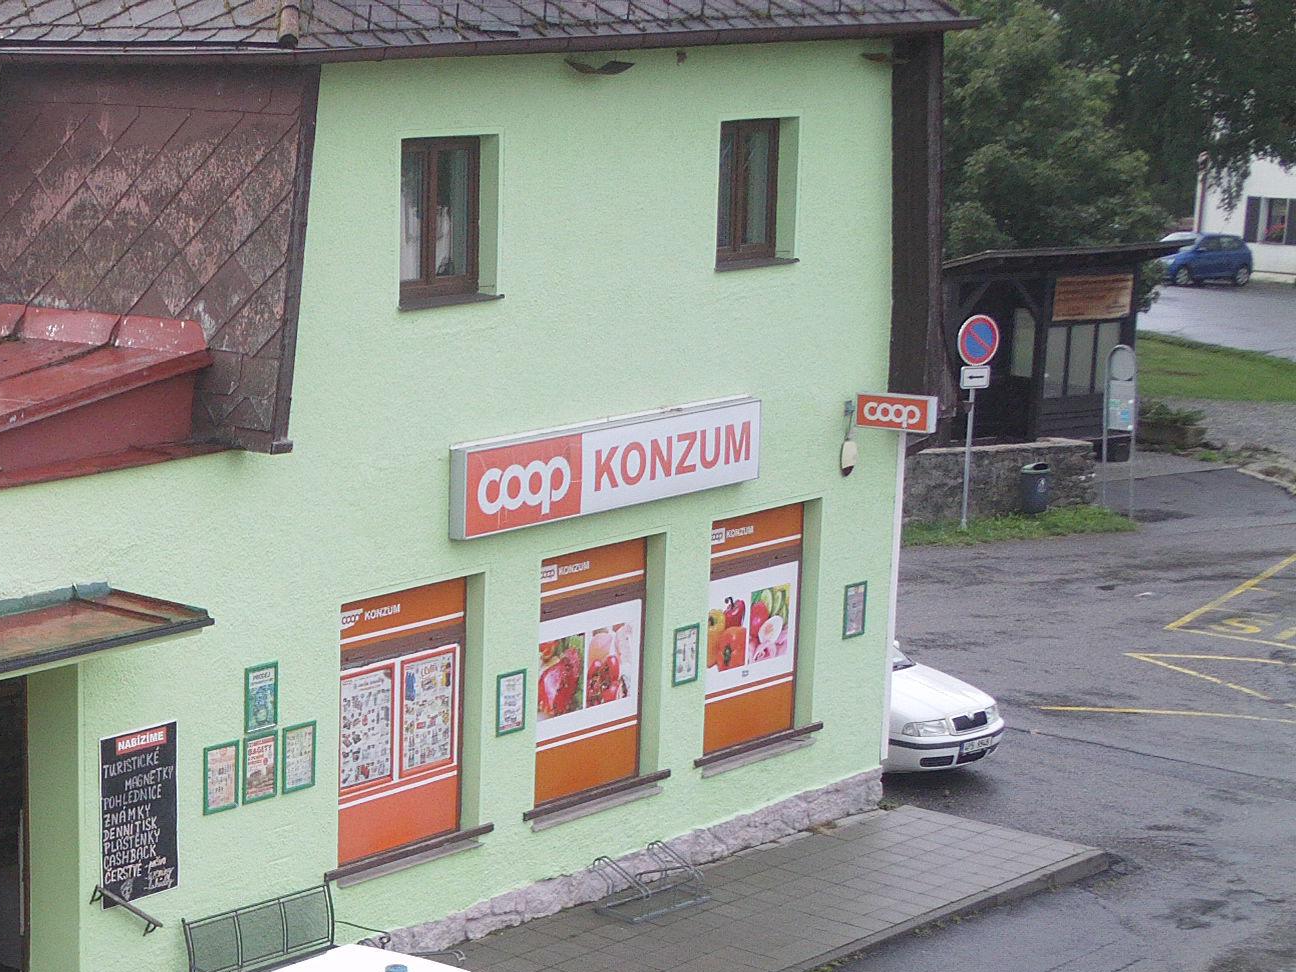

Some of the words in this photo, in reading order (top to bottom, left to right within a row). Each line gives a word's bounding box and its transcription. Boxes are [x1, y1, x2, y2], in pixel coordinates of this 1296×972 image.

[863, 401, 921, 428] coop
[477, 456, 571, 515] coop
[593, 420, 752, 493] KONZUM
[364, 604, 401, 620] KONZUM
[117, 731, 165, 750] NABÍZÍME
[103, 746, 160, 778] TURISTICKÉ
[124, 766, 174, 791] MAGNETKY
[102, 783, 162, 811] POHLEDNICE
[104, 803, 151, 827] ZNÁMKY
[134, 816, 157, 832] TISK
[103, 844, 157, 870] CASHBACK
